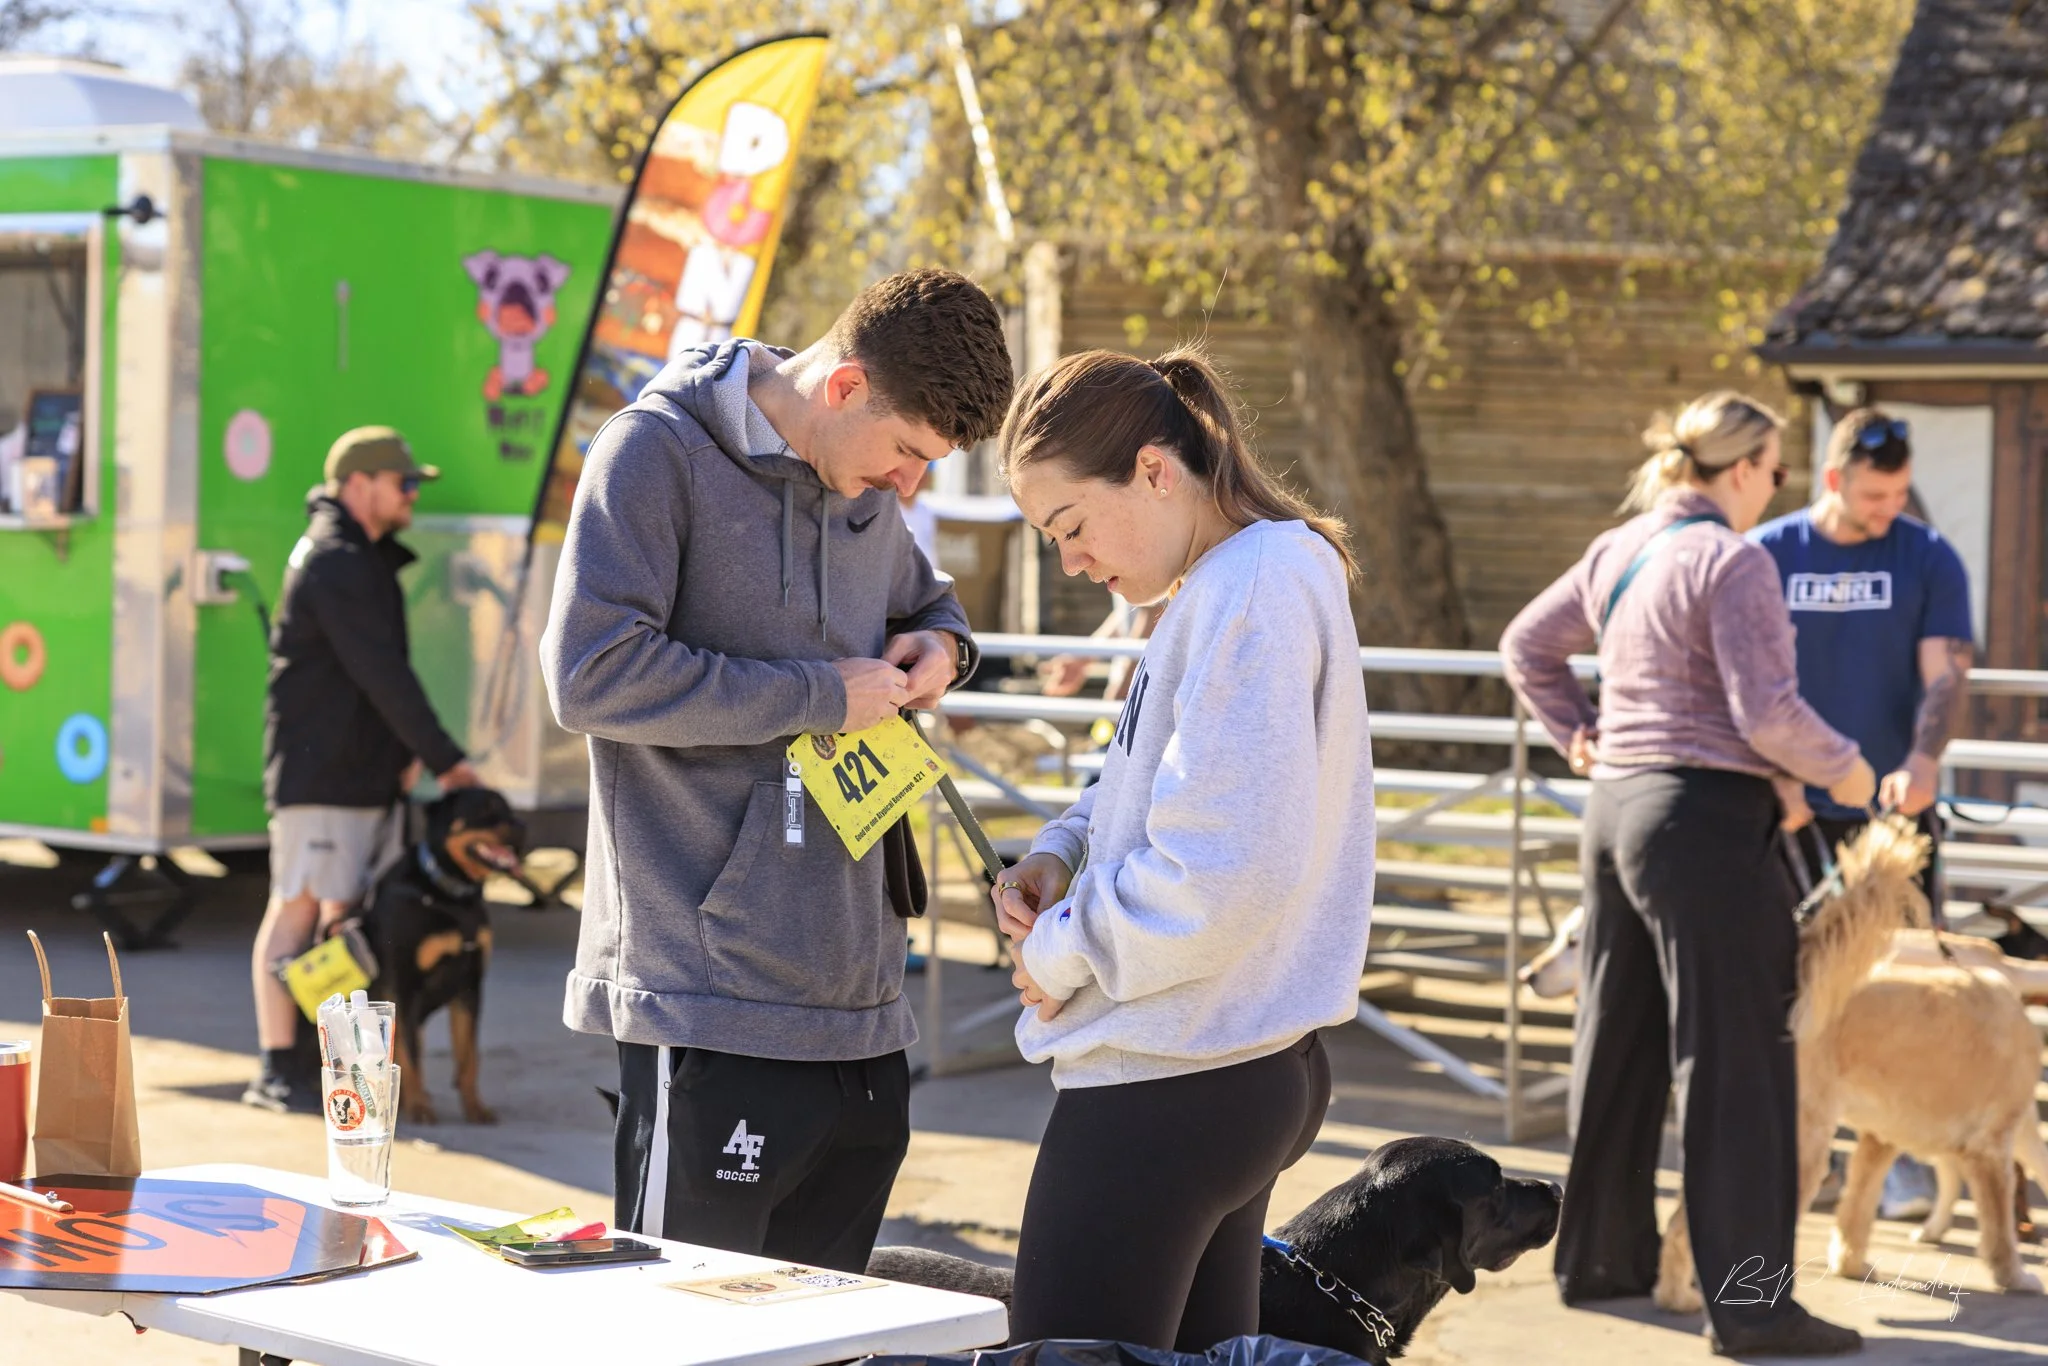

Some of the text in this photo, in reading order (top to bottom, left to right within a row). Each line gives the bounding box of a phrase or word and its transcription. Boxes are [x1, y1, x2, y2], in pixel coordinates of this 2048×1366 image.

[832, 739, 890, 804] 421
[854, 771, 926, 842] Good for one Atypical Beverage 421
[715, 1169, 760, 1182] SOCCER
[722, 1119, 765, 1170] AF
[0, 1199, 279, 1267] SLOW
